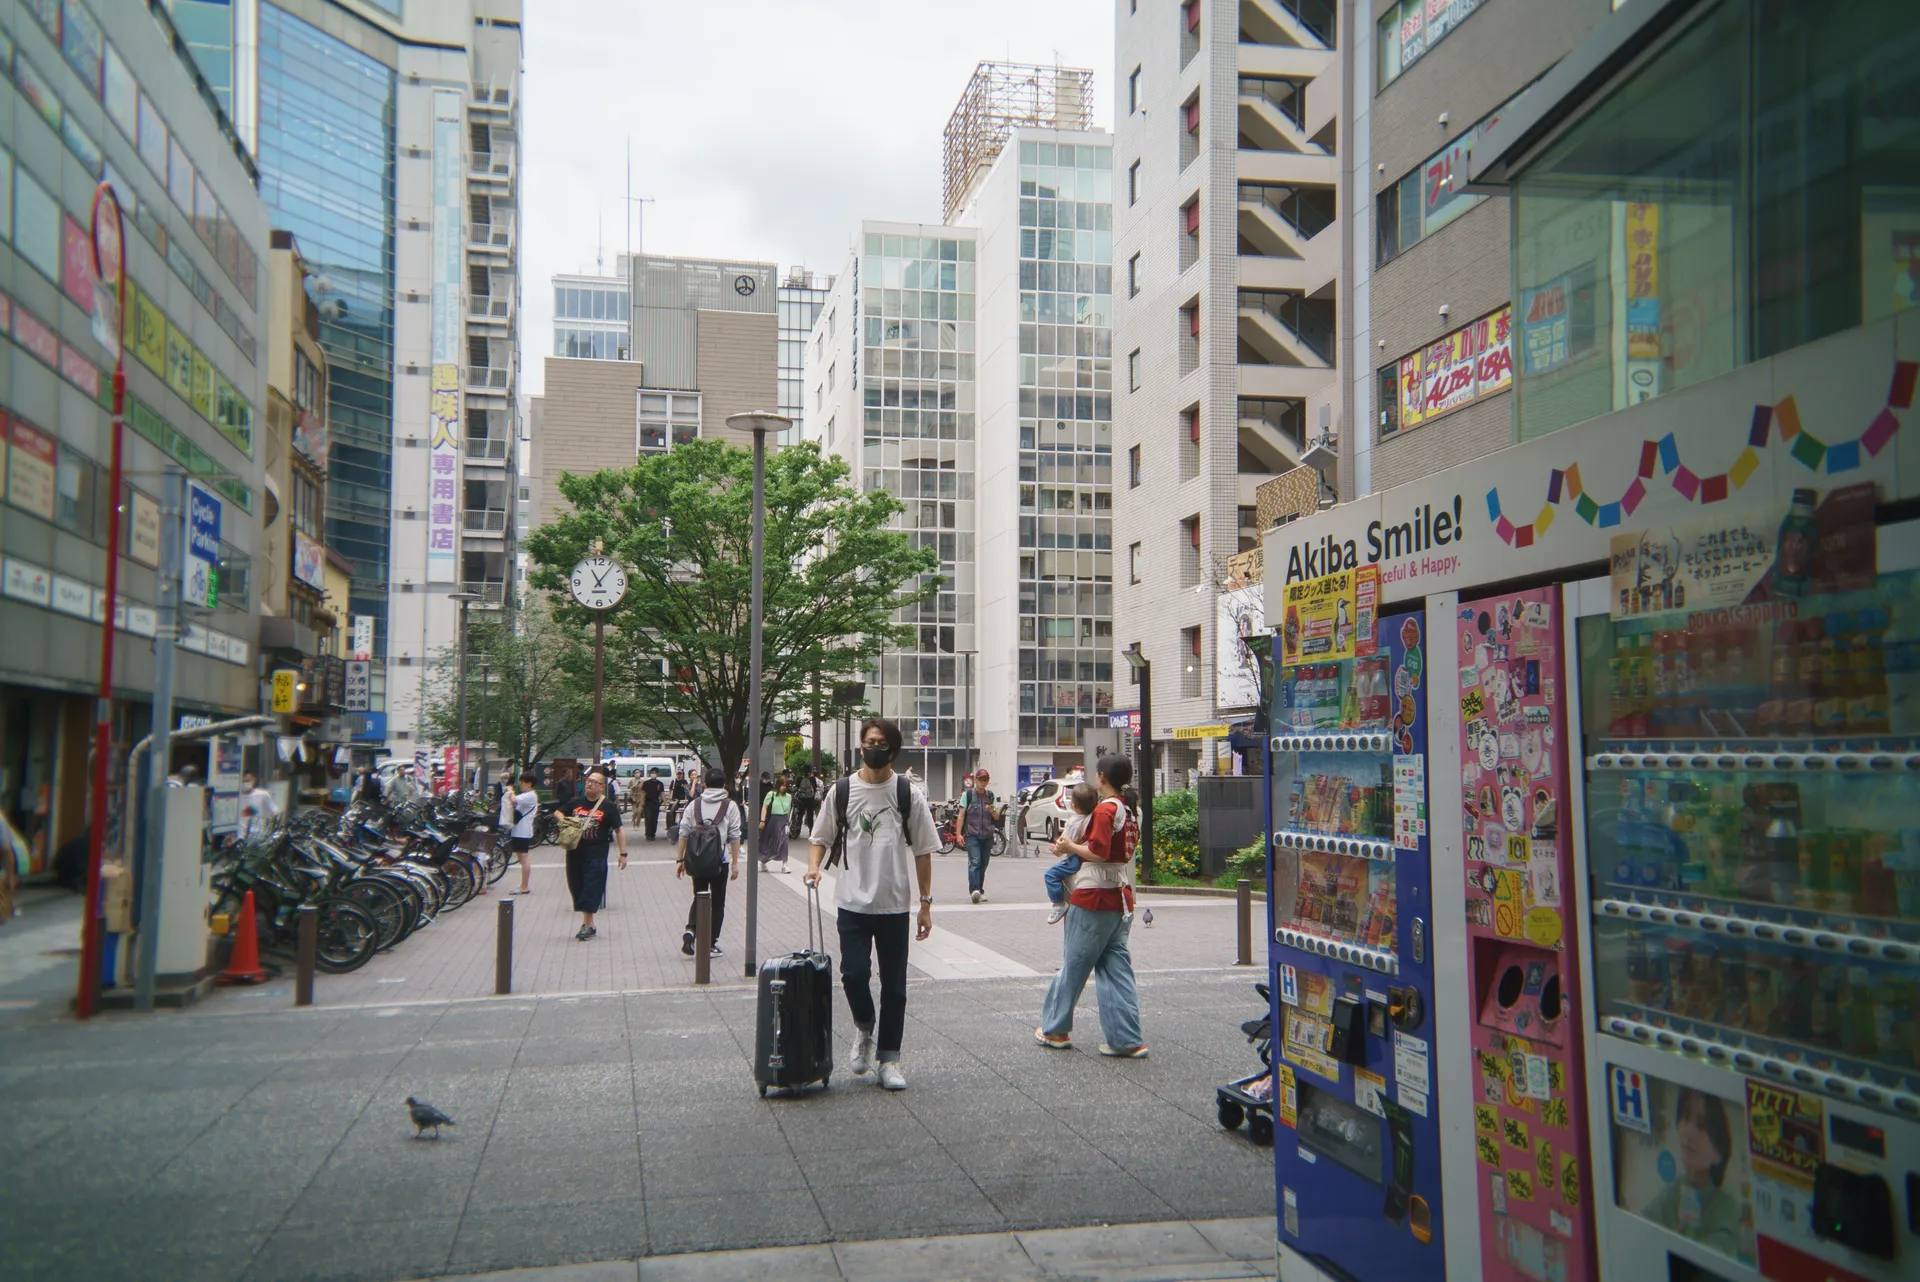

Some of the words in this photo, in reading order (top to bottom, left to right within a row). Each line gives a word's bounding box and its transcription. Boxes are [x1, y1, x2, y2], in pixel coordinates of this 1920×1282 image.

[191, 497, 214, 525] Cycle
[1286, 534, 1358, 585] Akiba
[1367, 494, 1462, 563] Smile!
[592, 558, 605, 566] 12
[1410, 560, 1418, 577] &
[1421, 555, 1461, 577] Happy.
[573, 579, 581, 587] 9
[617, 578, 624, 586] 3
[595, 599, 603, 607] 6
[355, 620, 365, 649] ラーメン
[1096, 745, 1107, 757] 秋
